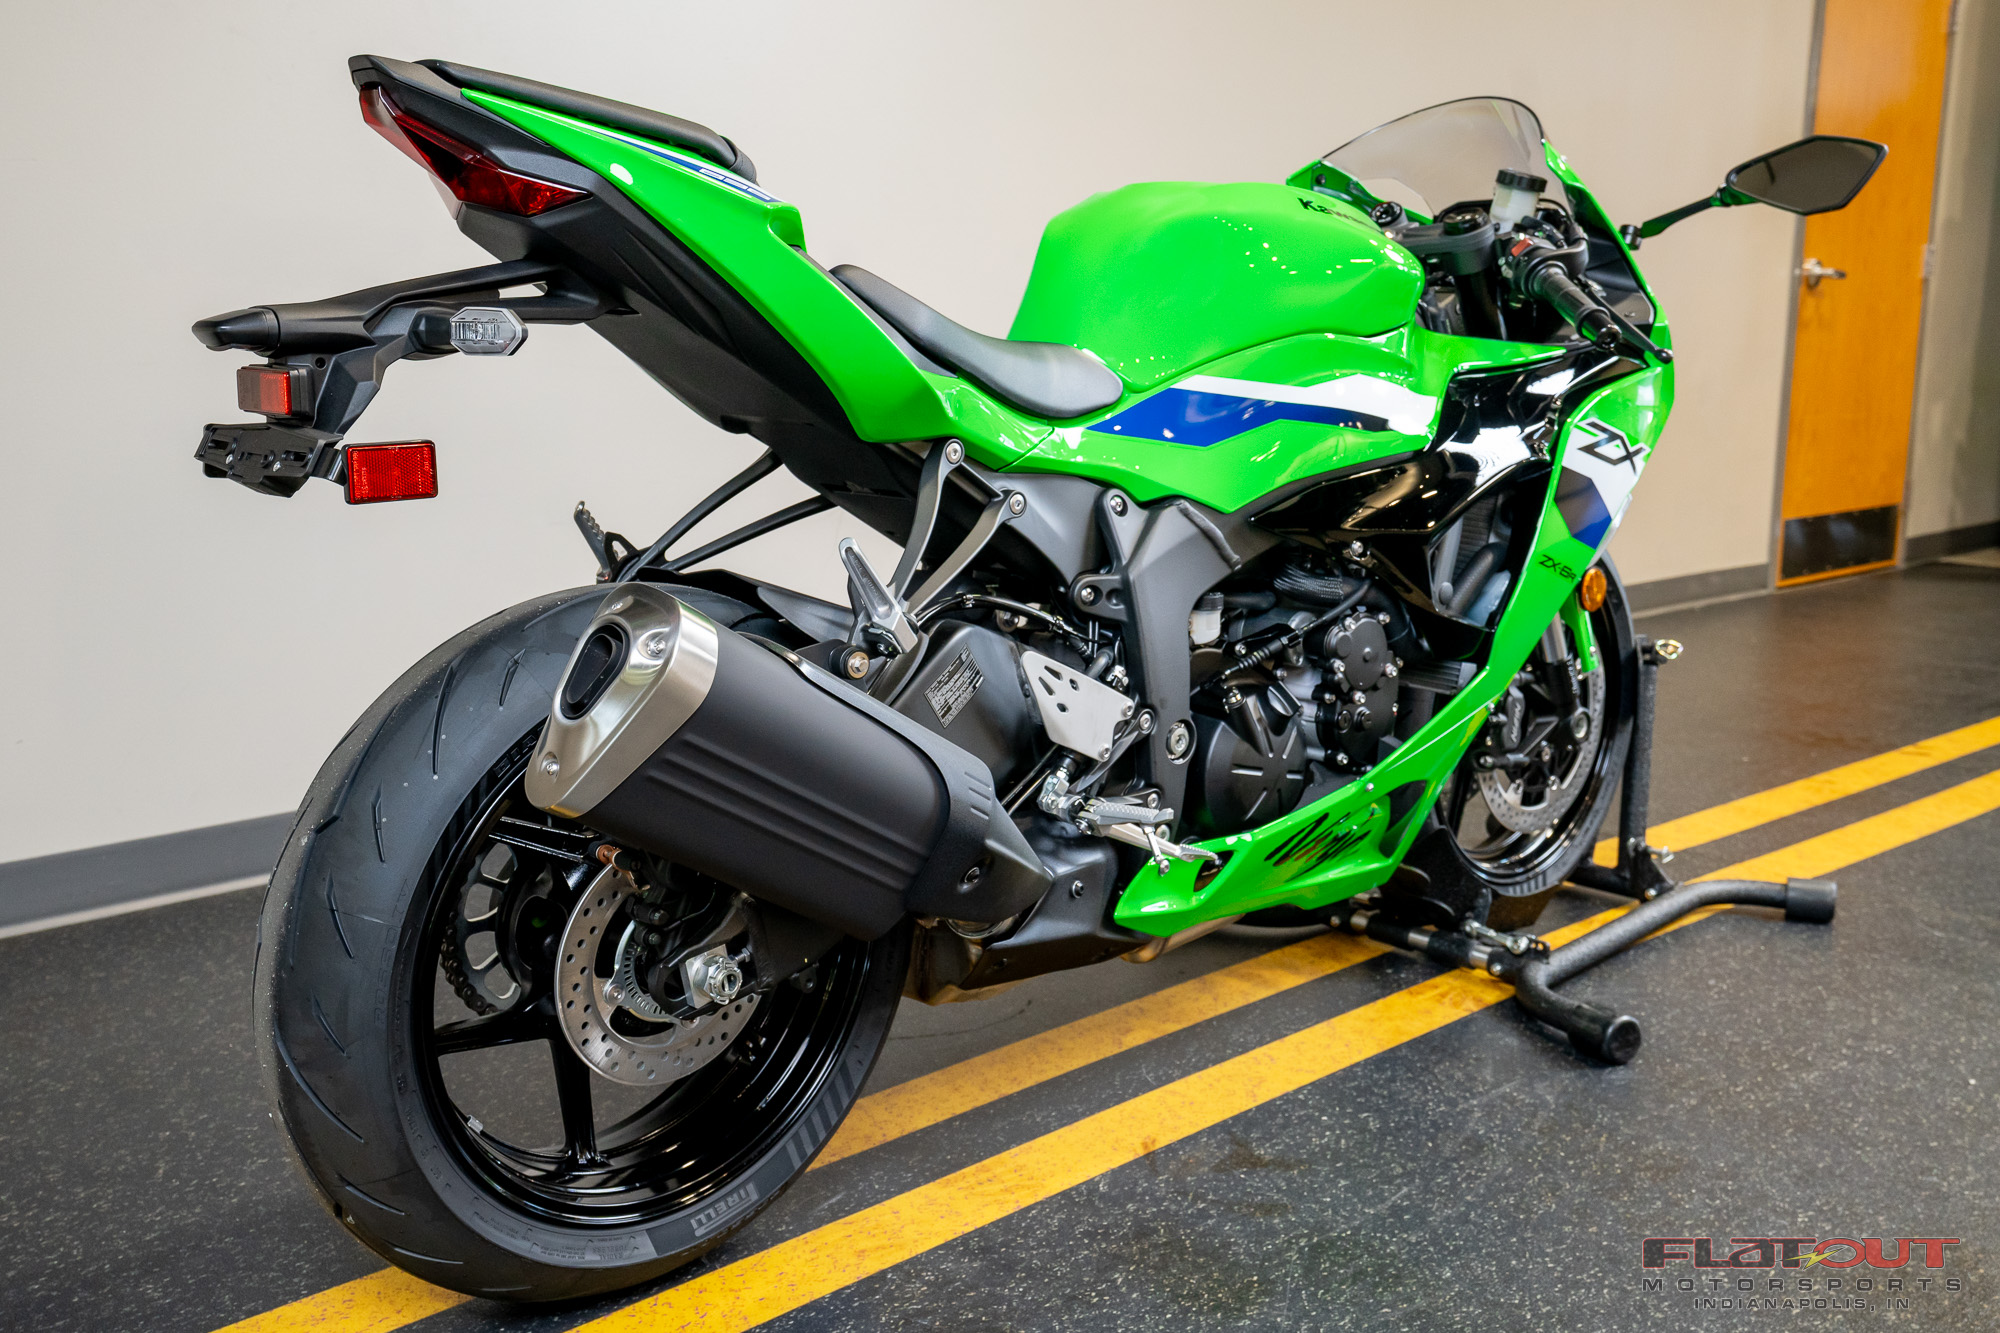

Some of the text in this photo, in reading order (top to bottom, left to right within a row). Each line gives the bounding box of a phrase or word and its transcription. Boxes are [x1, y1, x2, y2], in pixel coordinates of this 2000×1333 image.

[1577, 420, 1647, 475] ZX
[1538, 554, 1578, 583] ZX-6R
[690, 1181, 759, 1237] PIRELLI
